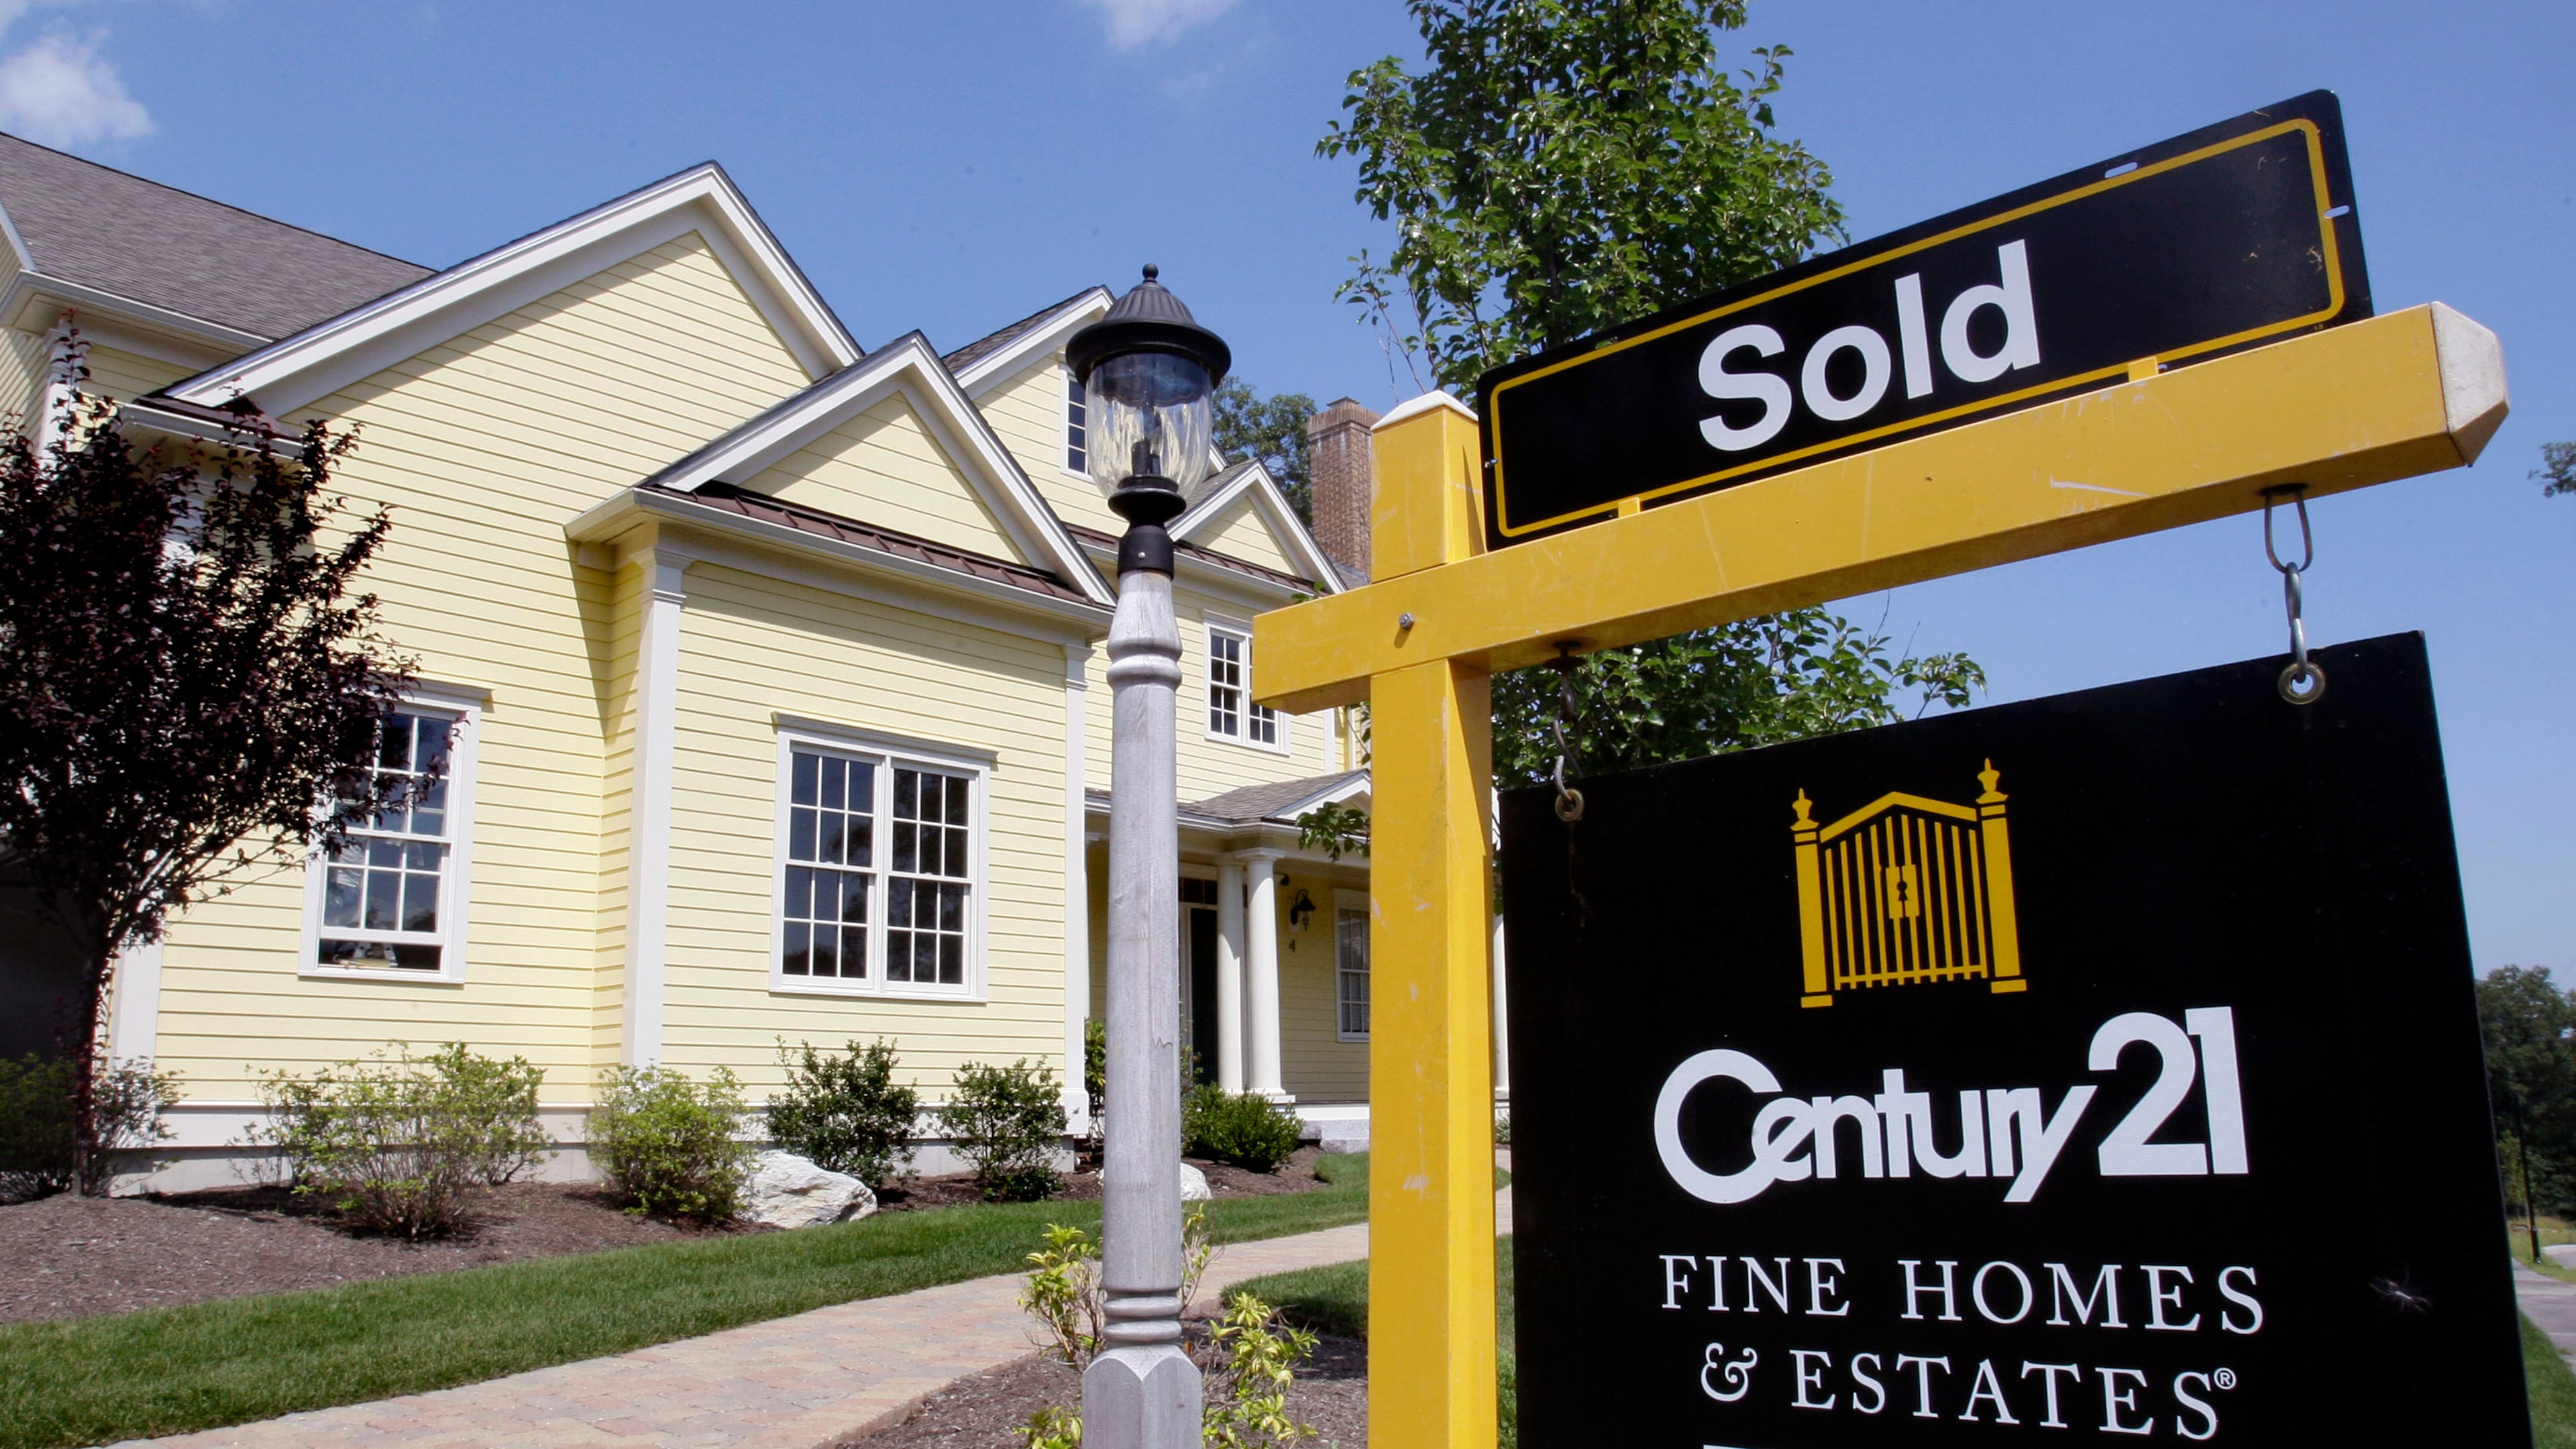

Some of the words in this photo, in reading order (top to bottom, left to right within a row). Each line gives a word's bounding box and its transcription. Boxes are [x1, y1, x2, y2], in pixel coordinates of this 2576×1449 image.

[1698, 239, 2041, 451] Sold
[1289, 939, 1296, 953] 4
[1654, 1049, 2098, 1204] Century
[2088, 1006, 2249, 1176] 21
[1659, 1254, 1849, 1316] FINE
[1898, 1260, 2263, 1334] HOMES
[1701, 1342, 1758, 1402] &
